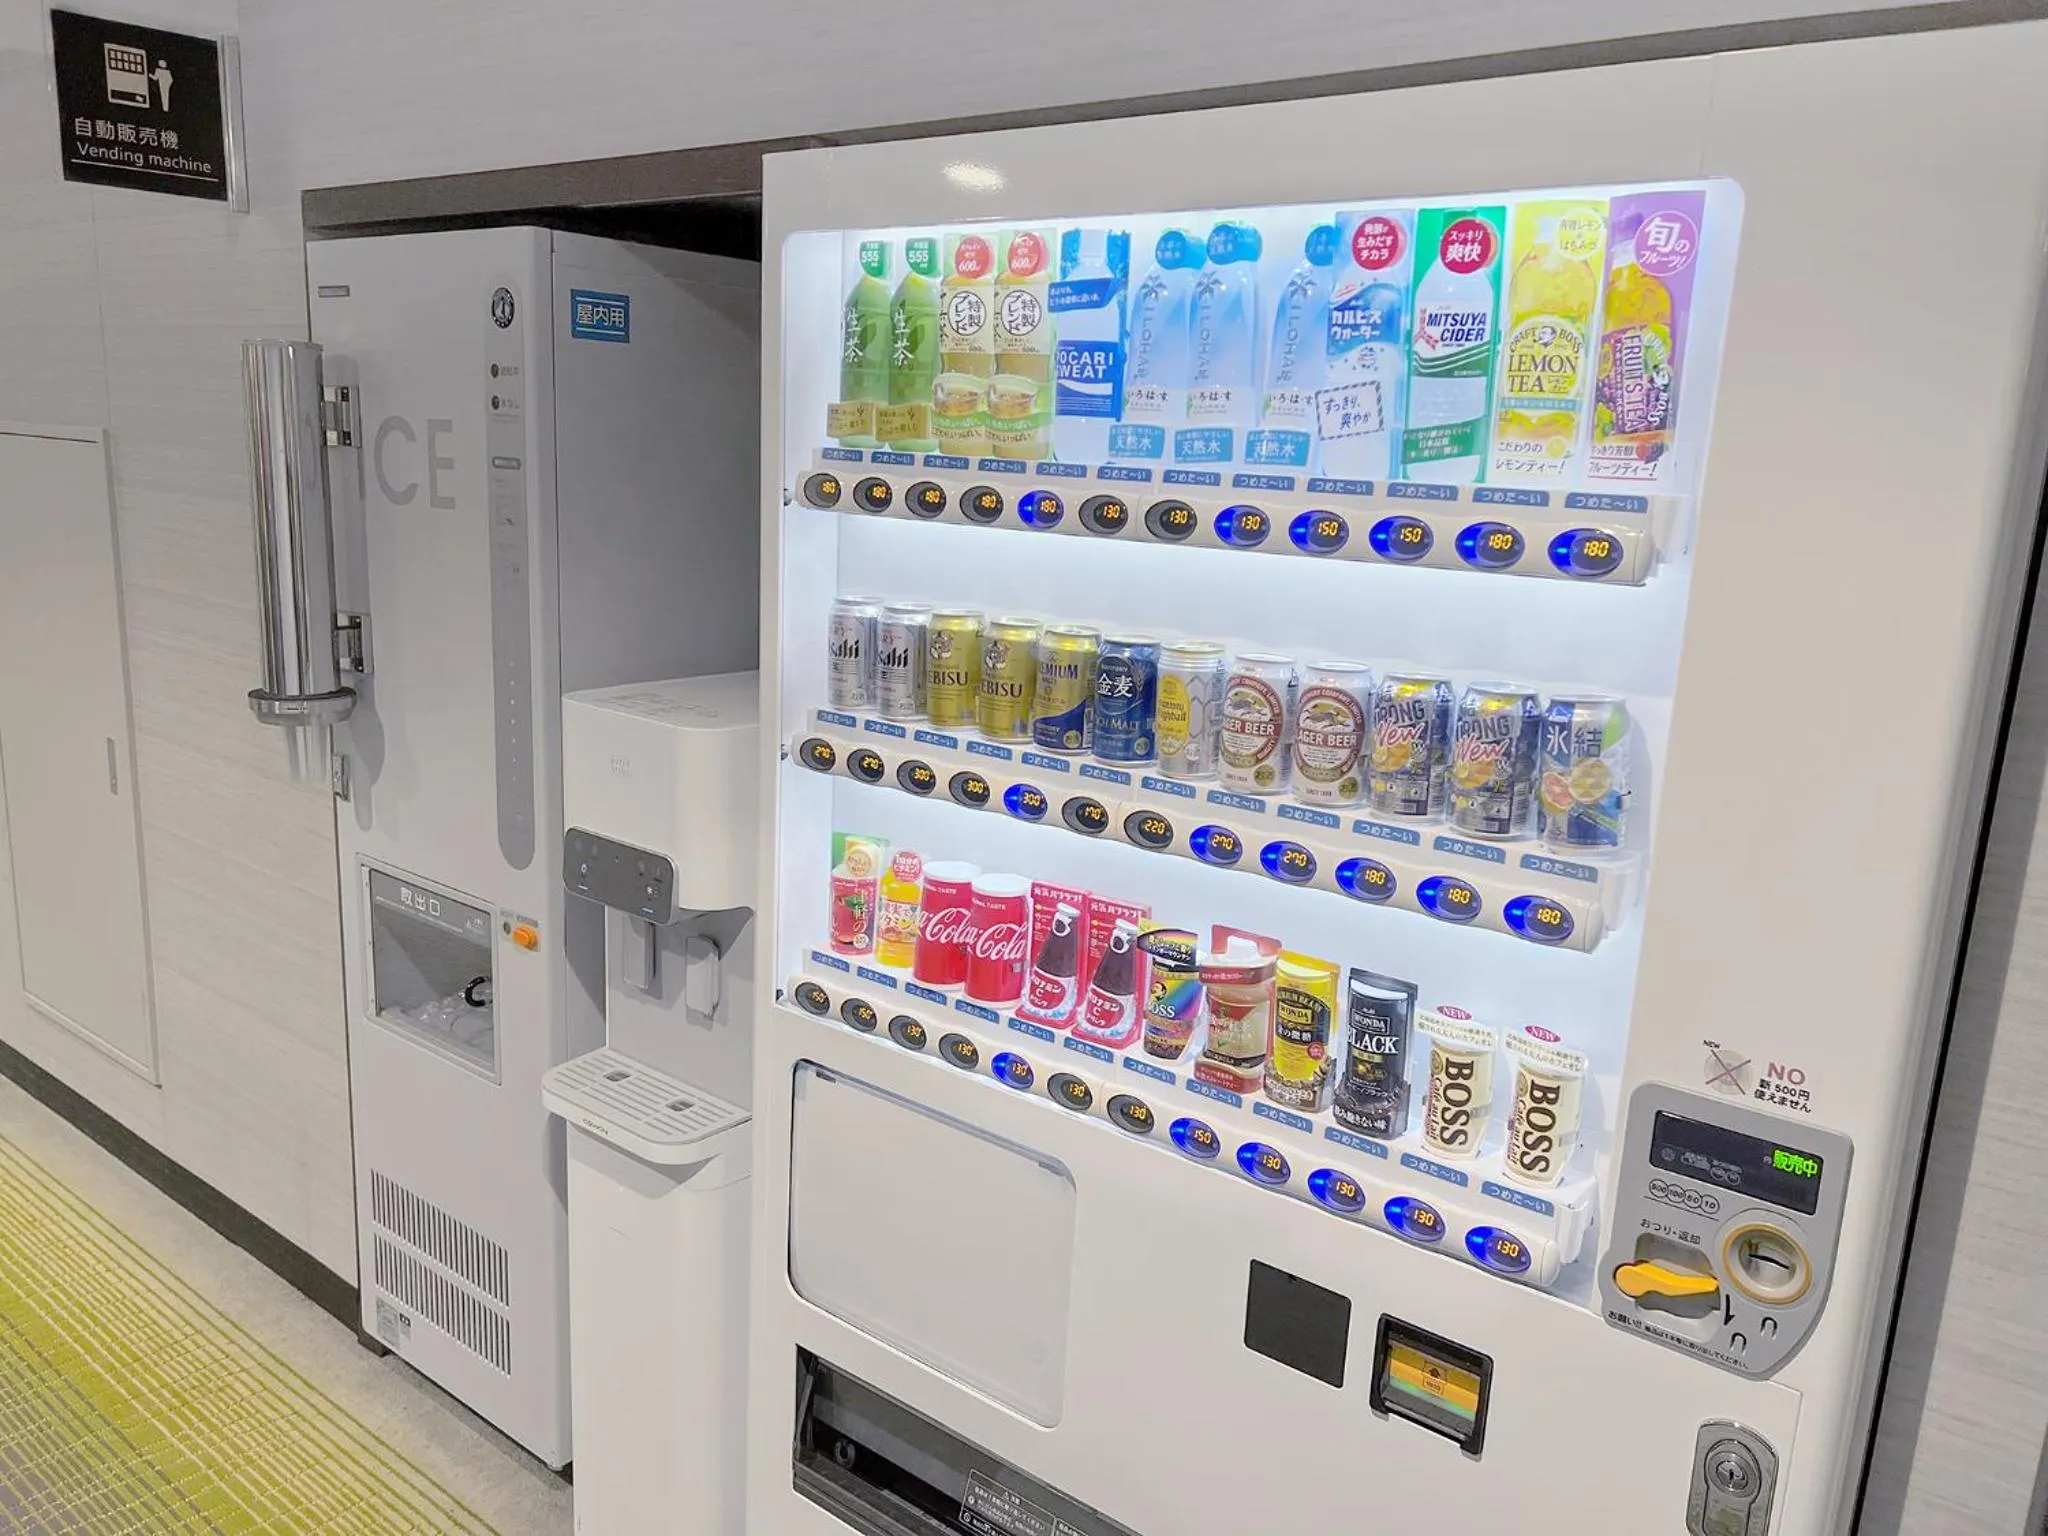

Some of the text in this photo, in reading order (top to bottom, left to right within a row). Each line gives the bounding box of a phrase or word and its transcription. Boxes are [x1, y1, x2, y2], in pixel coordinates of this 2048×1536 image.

[75, 117, 179, 152] 自動販売機
[77, 142, 212, 177] Vending machine
[1448, 229, 1484, 245] スッキリ
[1646, 216, 1690, 256] 旬の
[909, 250, 929, 264] 555
[1360, 251, 1390, 265] チカラ
[1446, 243, 1482, 264] 爽快
[577, 303, 625, 328] 屋内用
[1331, 308, 1383, 326] カルピス
[1427, 313, 1487, 329] MITSUYA
[1440, 328, 1485, 342] CIDER
[1558, 327, 1583, 355] BOSS
[1057, 351, 1114, 366] OCARI
[1508, 354, 1579, 375] LEMON
[1508, 374, 1546, 393] TEA
[1622, 333, 1650, 432] FRUITS TEA
[1498, 440, 1543, 455] こだわりの
[1103, 505, 1120, 519] 130
[1170, 510, 1188, 524] 130
[1241, 515, 1261, 530] 130
[1318, 521, 1339, 537] 150
[1400, 527, 1422, 543] 150
[1488, 534, 1513, 550] 180
[1583, 541, 1610, 558] 180
[829, 638, 860, 660] sahi
[877, 647, 909, 668] sahi
[928, 670, 968, 686] EBISU
[1097, 673, 1133, 697] 金麦
[980, 680, 1022, 699] EBISU
[1245, 723, 1275, 740] BEER
[1375, 722, 1427, 748] New
[1297, 732, 1358, 752] AGER BEER
[1456, 734, 1512, 762] New
[1545, 725, 1605, 757] 氷結
[1022, 792, 1042, 807] 300
[1144, 819, 1165, 835] 220
[1283, 850, 1308, 867] 270
[1364, 867, 1387, 885] 180
[400, 886, 441, 917] 取出口
[1448, 887, 1472, 905] 180
[1537, 906, 1562, 926] 180
[1442, 1005, 1468, 1020] NEW
[1354, 1015, 1387, 1033] WONDA
[1530, 1025, 1556, 1042] NEW
[1012, 1060, 1029, 1078] 130
[1767, 1062, 1806, 1086] NO
[1069, 1081, 1087, 1099] 130
[1439, 1057, 1475, 1147] BOSS
[1754, 1087, 1812, 1114] 使えません
[1129, 1102, 1149, 1121] 130
[1194, 1126, 1213, 1145] 150
[1520, 1079, 1561, 1174] BOSS
[1262, 1153, 1282, 1171] 130
[1773, 1148, 1818, 1178] 販売中
[1336, 1180, 1357, 1199] 130
[1651, 1183, 1667, 1196] 500
[1669, 1189, 1684, 1201] 100
[1686, 1194, 1700, 1206] 50
[1704, 1200, 1717, 1210] 10
[1414, 1208, 1435, 1228] 130
[1497, 1239, 1521, 1259] 130
